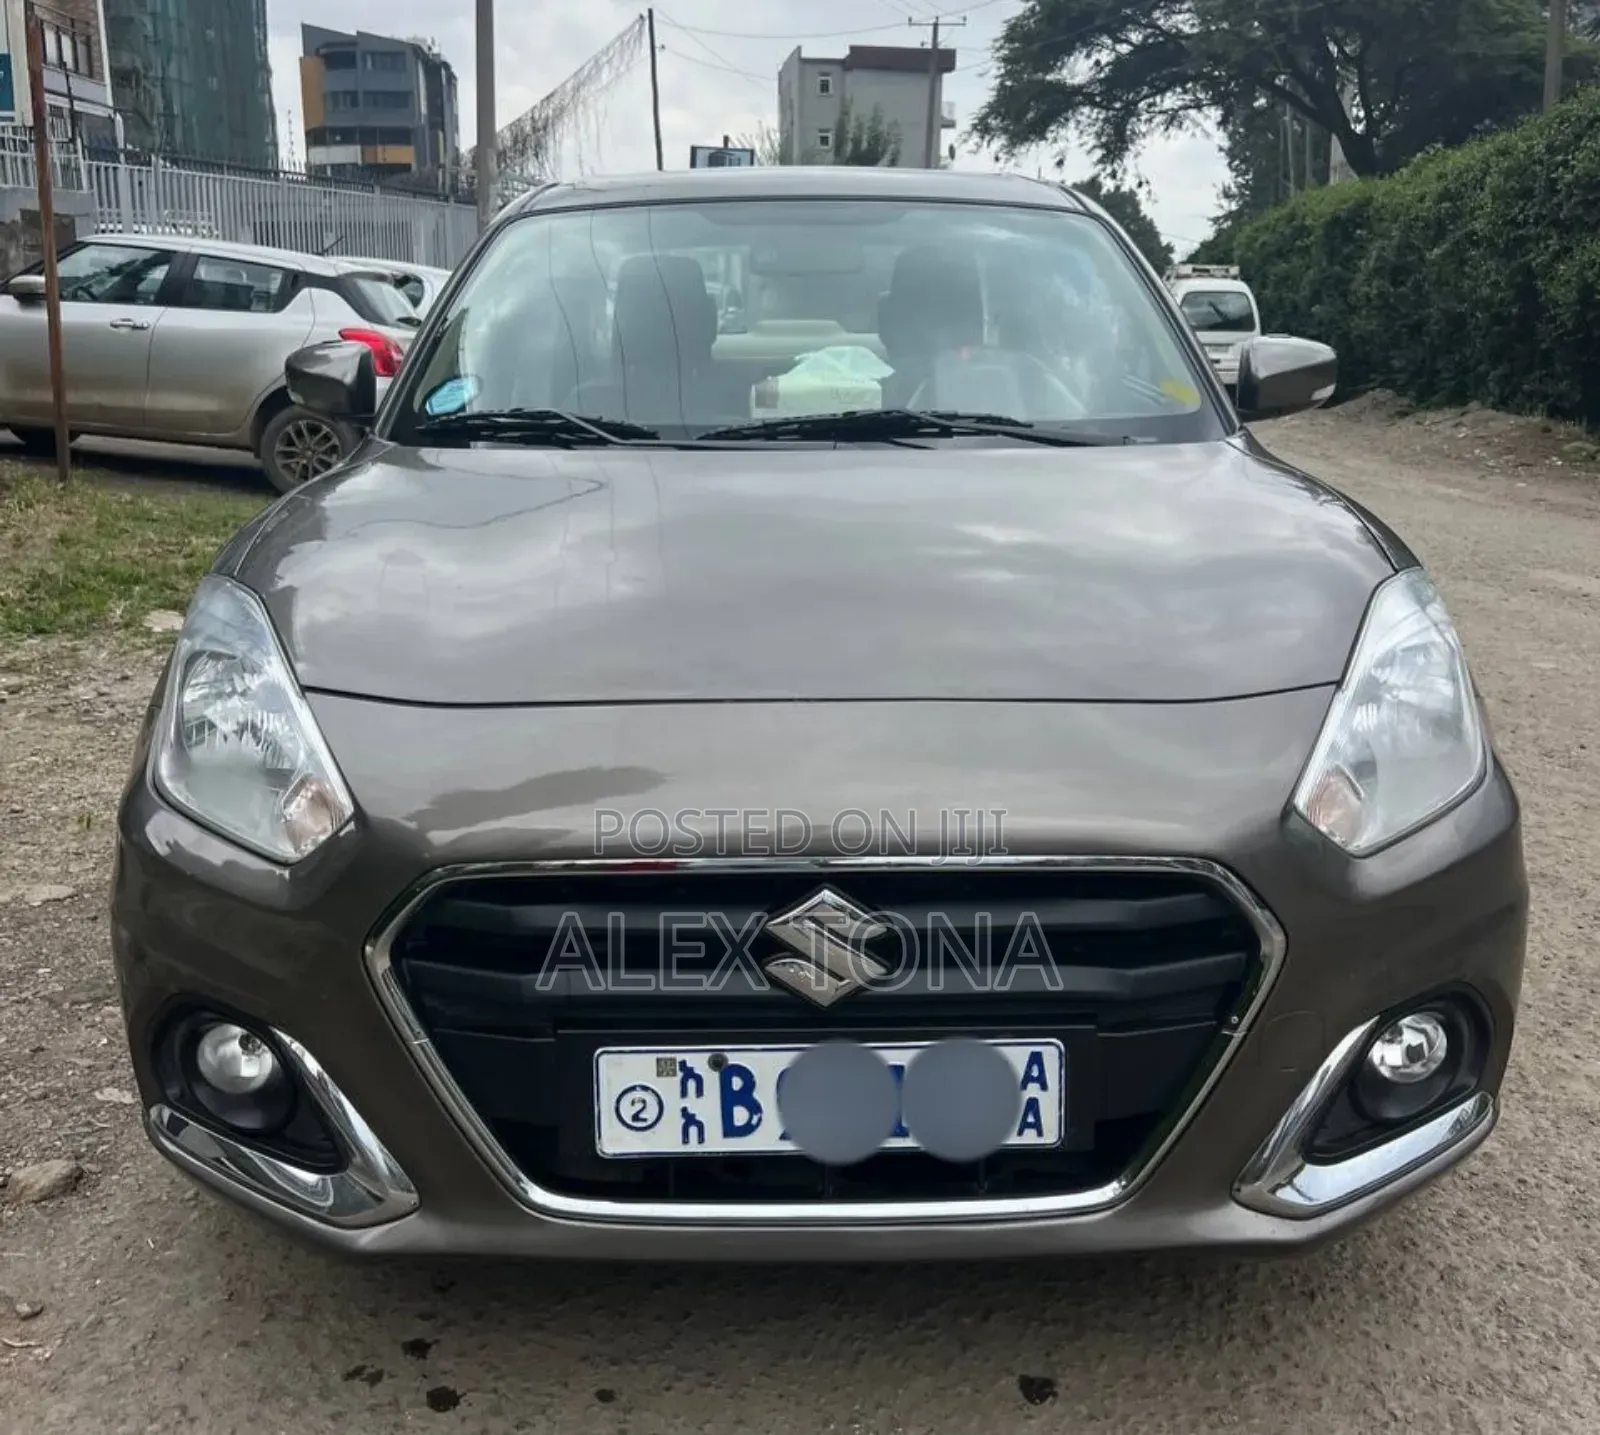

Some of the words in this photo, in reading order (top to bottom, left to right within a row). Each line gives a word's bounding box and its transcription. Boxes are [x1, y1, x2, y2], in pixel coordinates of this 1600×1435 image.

[1019, 1051, 1049, 1092] A
[630, 1096, 648, 1123] 2
[1017, 1096, 1044, 1138] A
